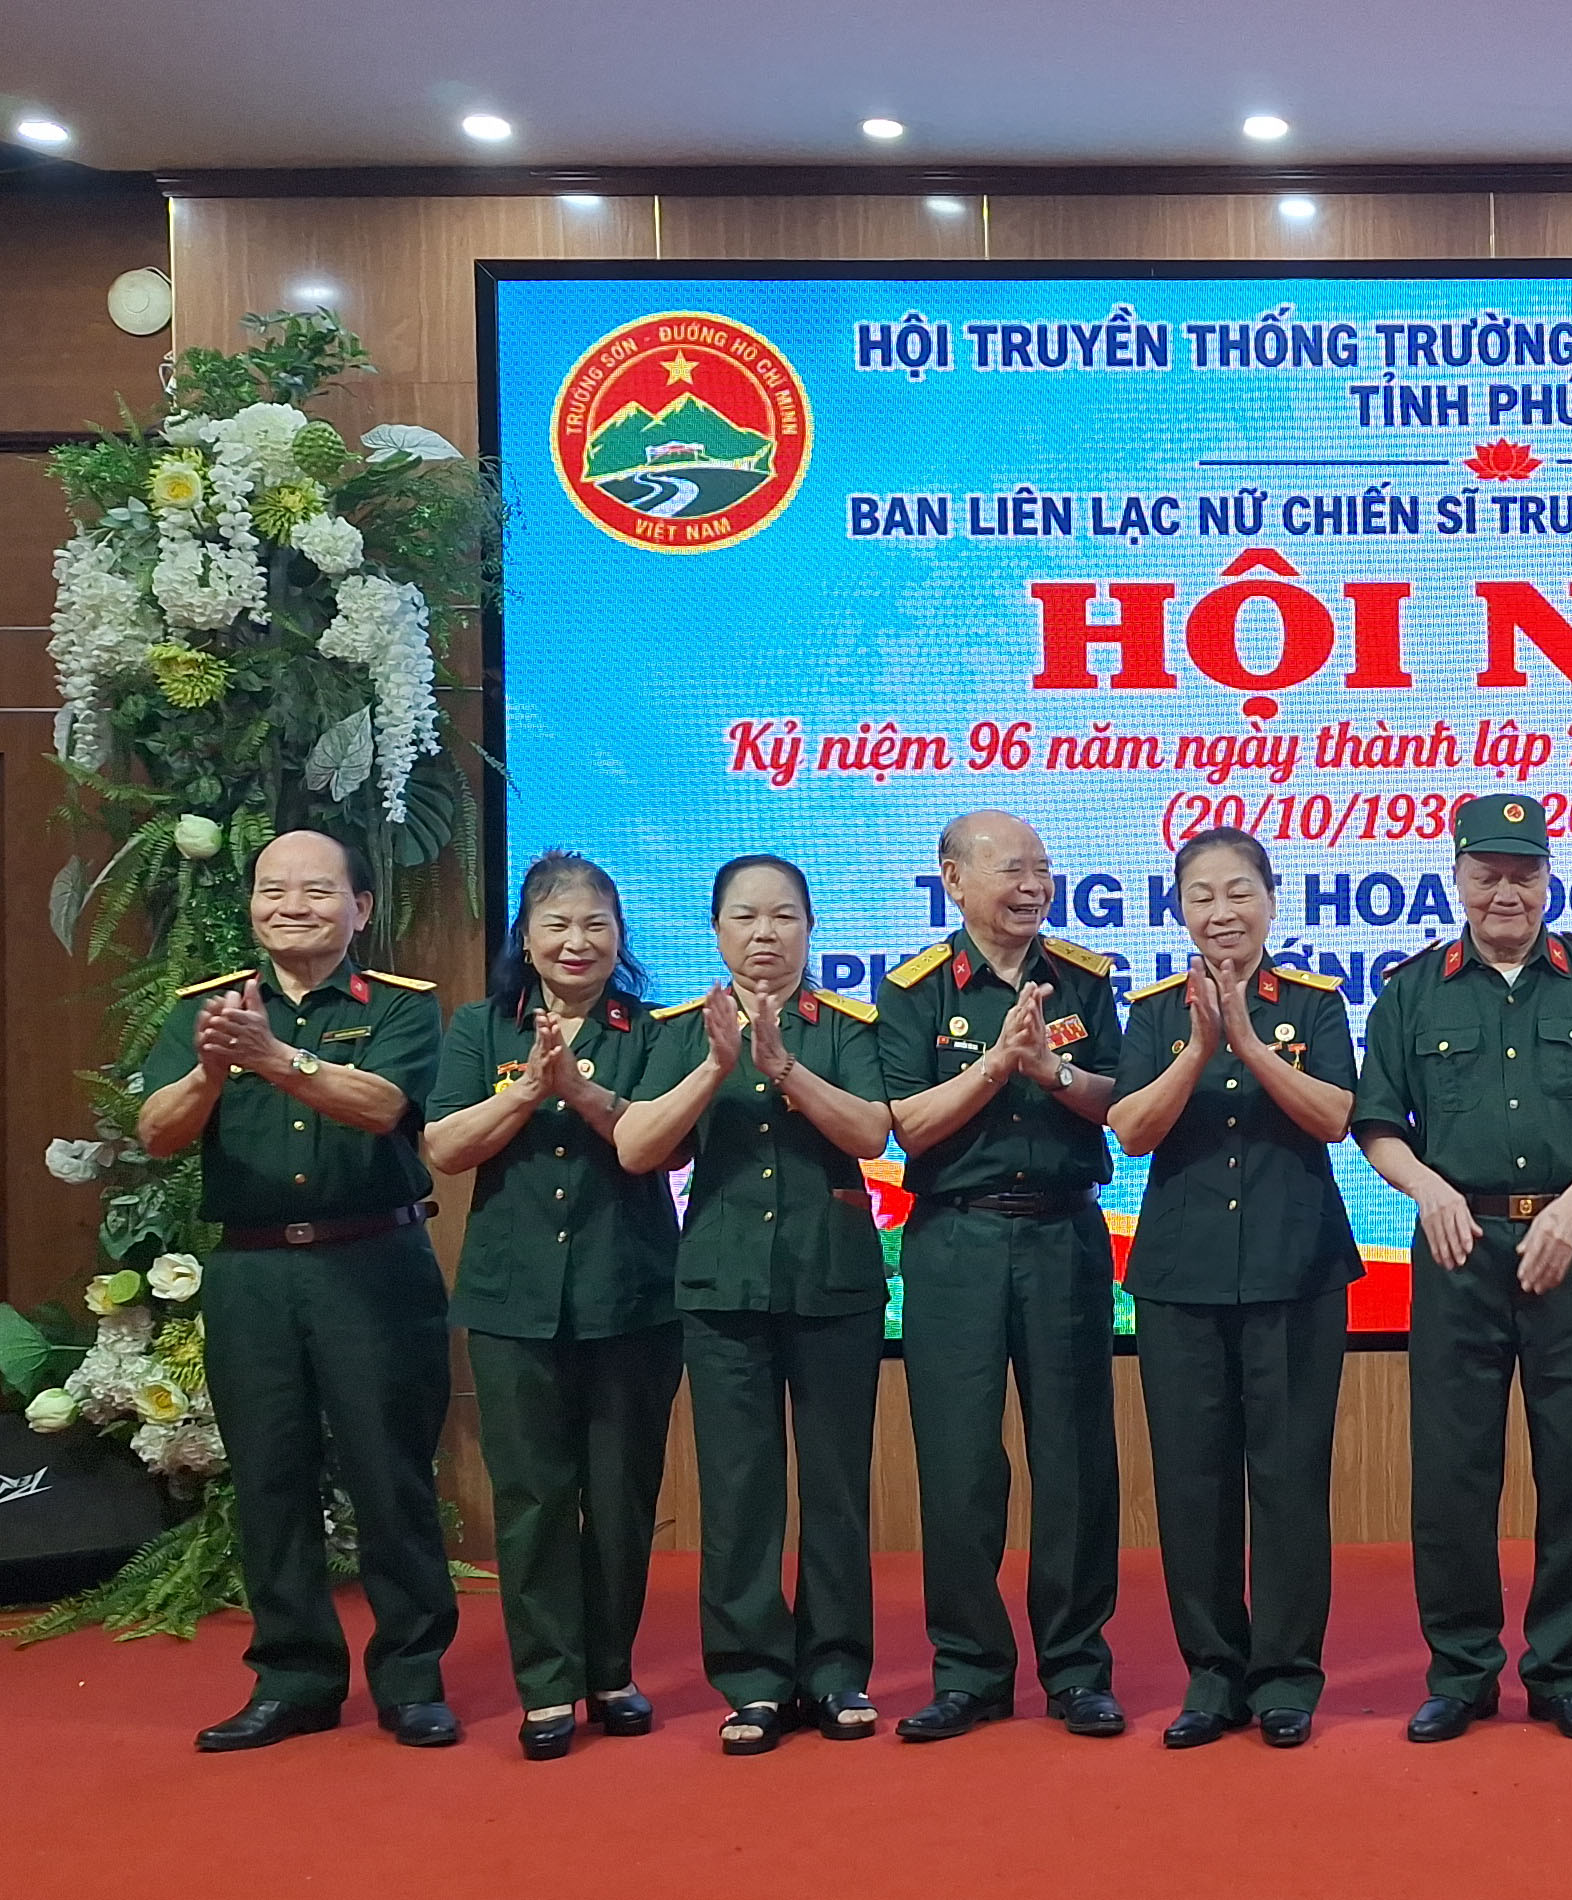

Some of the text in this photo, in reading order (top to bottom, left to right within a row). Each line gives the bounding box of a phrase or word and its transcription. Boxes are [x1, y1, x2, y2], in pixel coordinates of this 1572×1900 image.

[858, 312, 948, 379] HỘI
[968, 306, 1168, 369] TRUYỀN
[1186, 305, 1358, 368] THỐNG
[600, 337, 639, 368] SƠN
[774, 389, 798, 435] MINH
[1350, 371, 1469, 427] TỈNH
[635, 516, 732, 543] VIỆT NAM
[851, 496, 948, 536] BAN
[970, 486, 1072, 536] LIÊN
[1091, 496, 1180, 546] LẠC
[1199, 487, 1268, 536] NỮ
[1282, 481, 1421, 535] CHIẾN
[1437, 485, 1476, 535] SĨ
[1031, 548, 1412, 719] HỘI
[729, 719, 802, 787] Kỷ
[818, 721, 952, 781] niệm
[969, 721, 1032, 771] 96
[1046, 721, 1165, 770] năm
[1174, 716, 1301, 785] ngày
[1316, 718, 1461, 769] thành
[1473, 717, 1552, 781] lập
[1304, 871, 1456, 938] HOẠ
